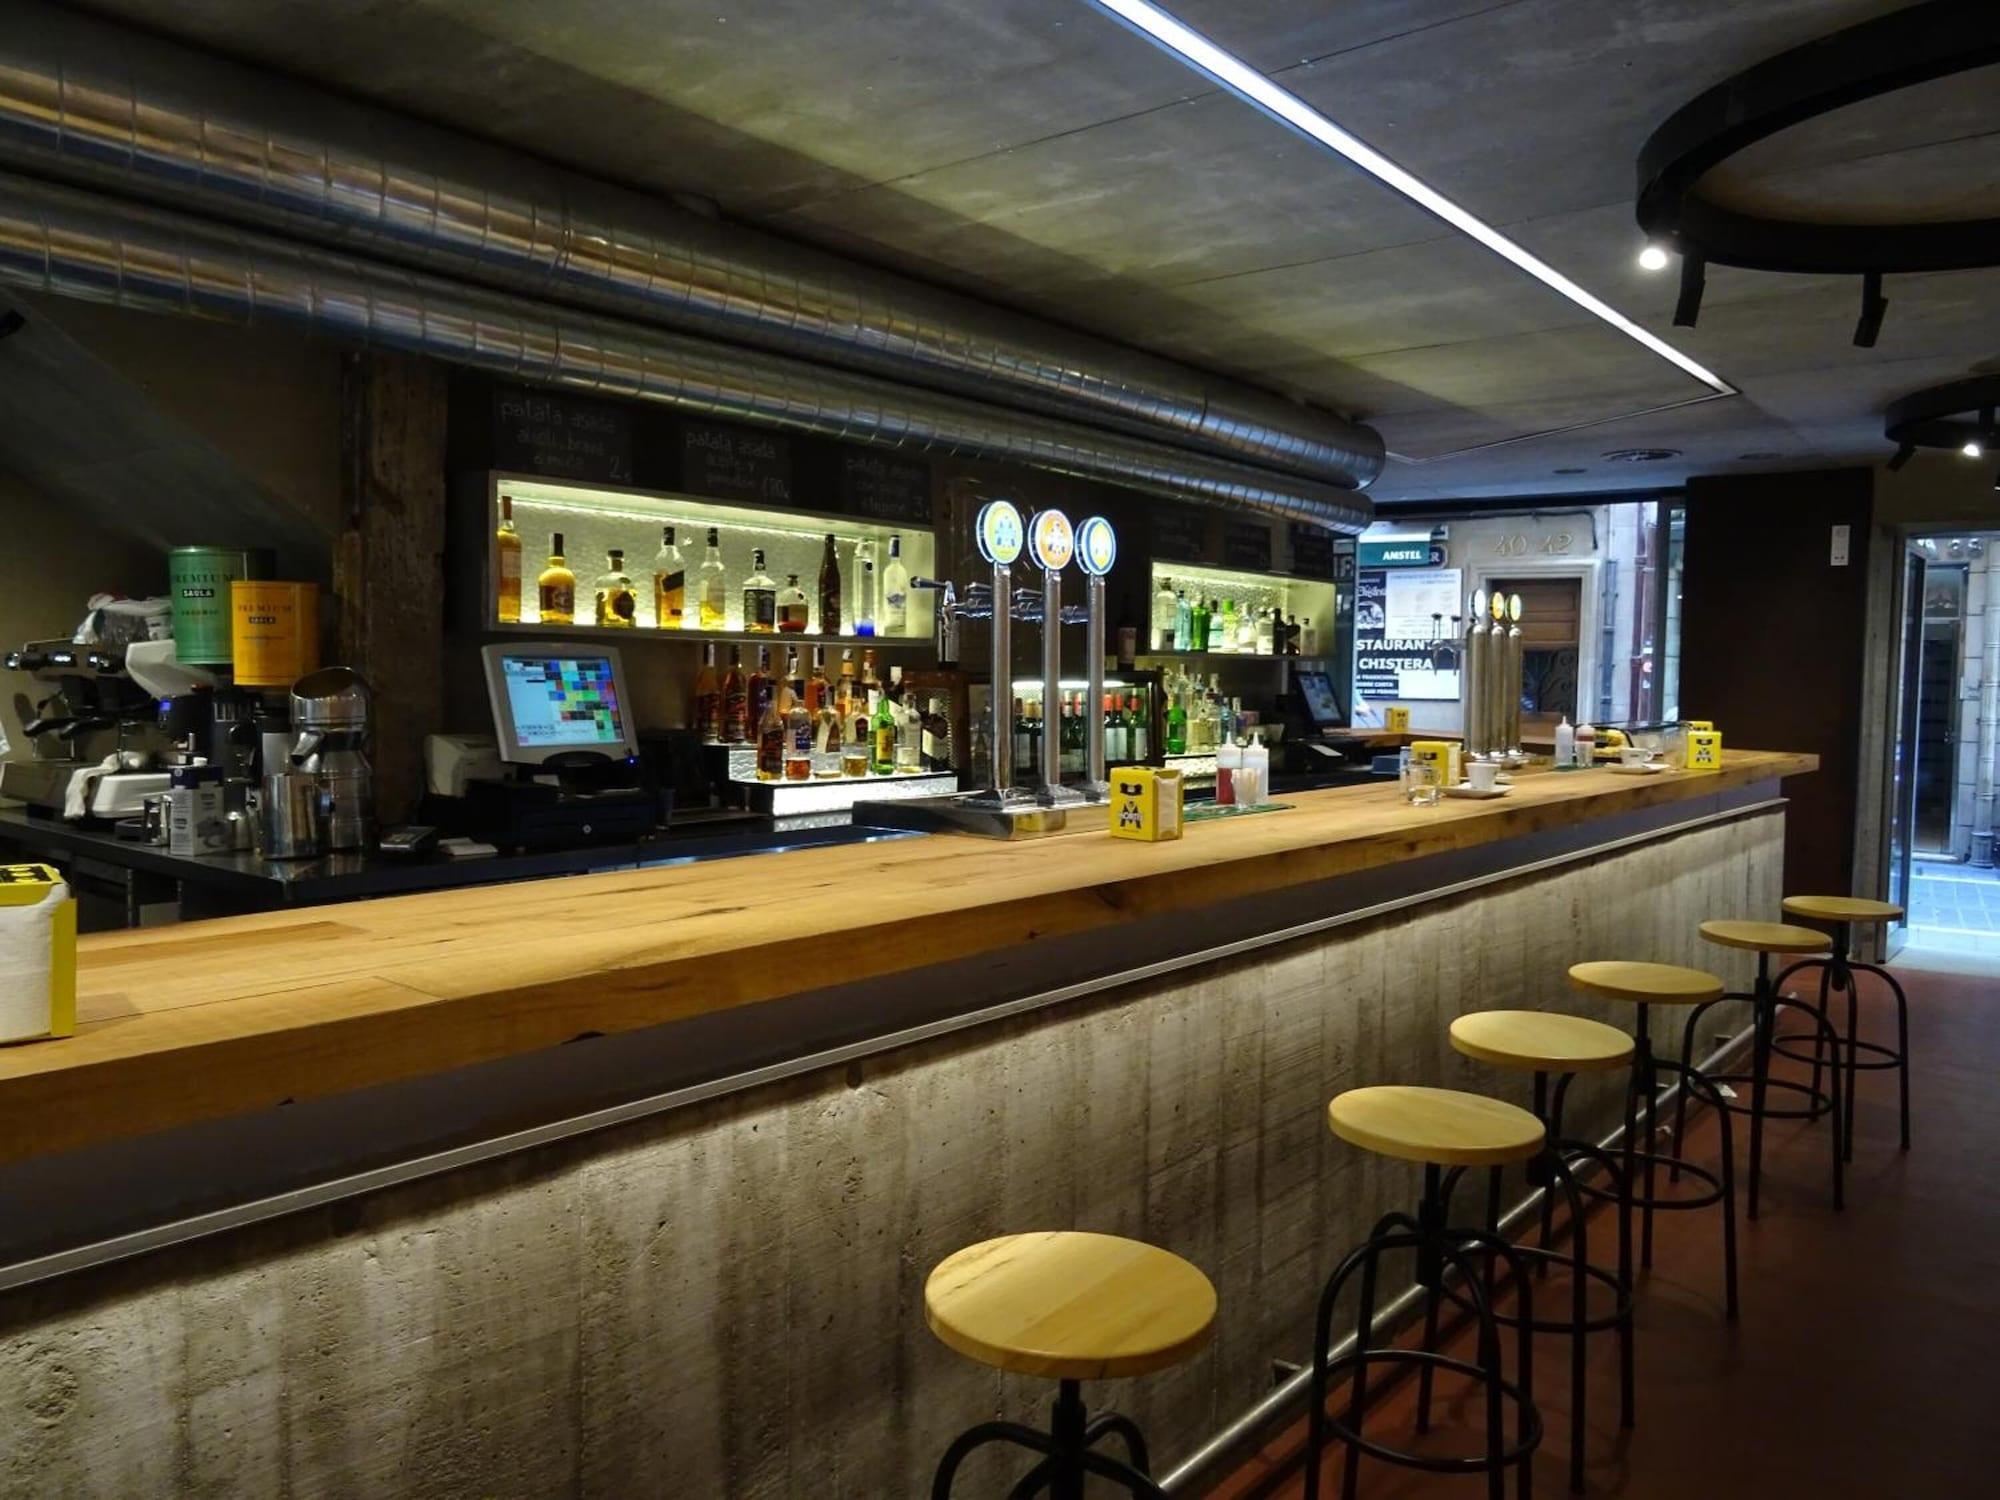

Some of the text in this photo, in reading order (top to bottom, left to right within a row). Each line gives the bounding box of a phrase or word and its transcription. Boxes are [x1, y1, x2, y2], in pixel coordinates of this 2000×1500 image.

[1490, 535, 1528, 556] 40
[1382, 550, 1422, 561] AMSTEL
[1358, 657, 1433, 670] CHISTERA
